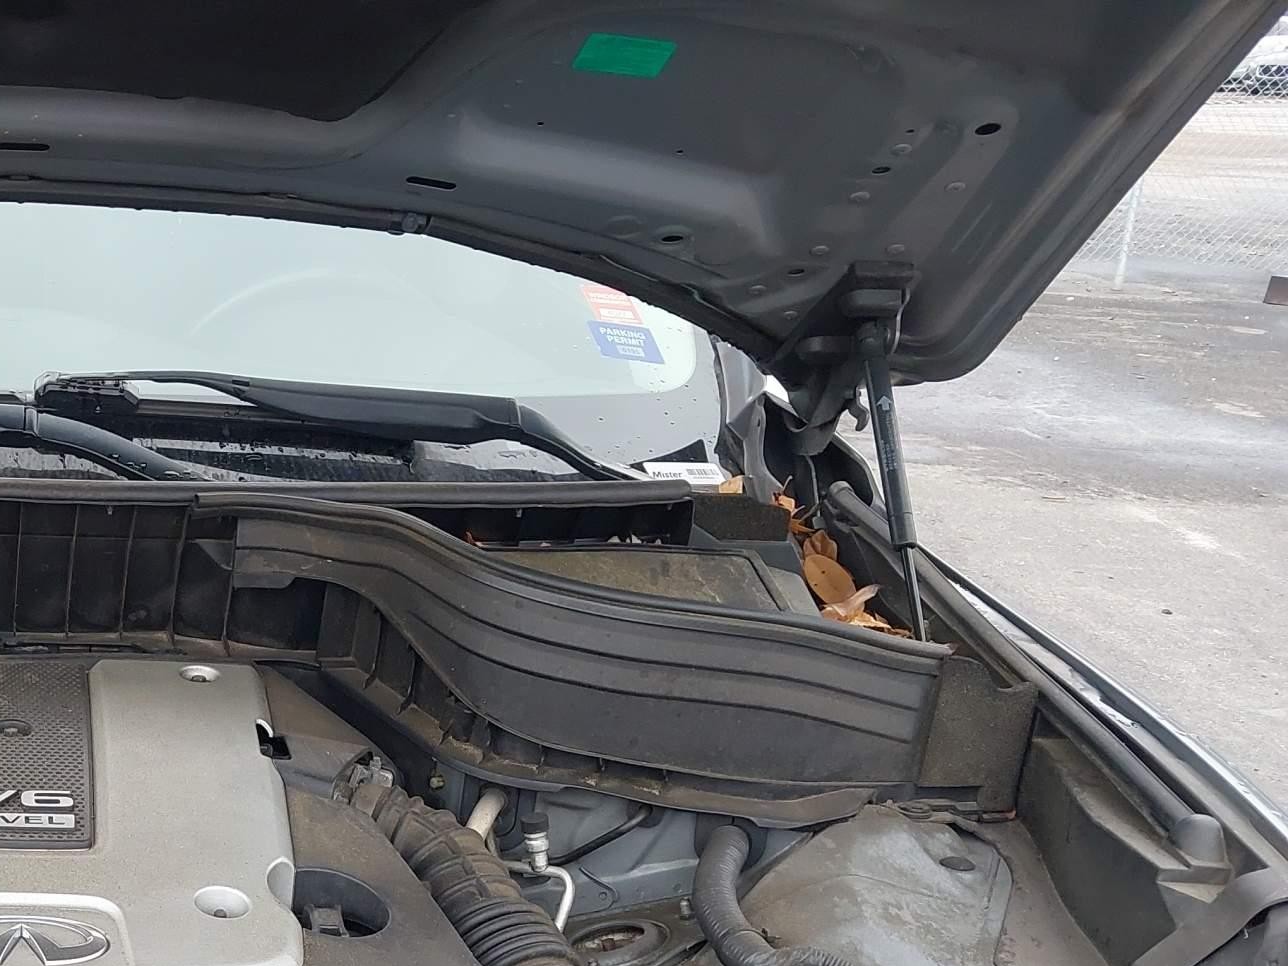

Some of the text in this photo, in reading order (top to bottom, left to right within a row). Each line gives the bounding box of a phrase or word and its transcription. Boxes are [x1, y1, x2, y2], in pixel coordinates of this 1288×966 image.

[599, 327, 646, 339] PARKING
[607, 335, 645, 346] PERMIT
[652, 471, 683, 479] Mister
